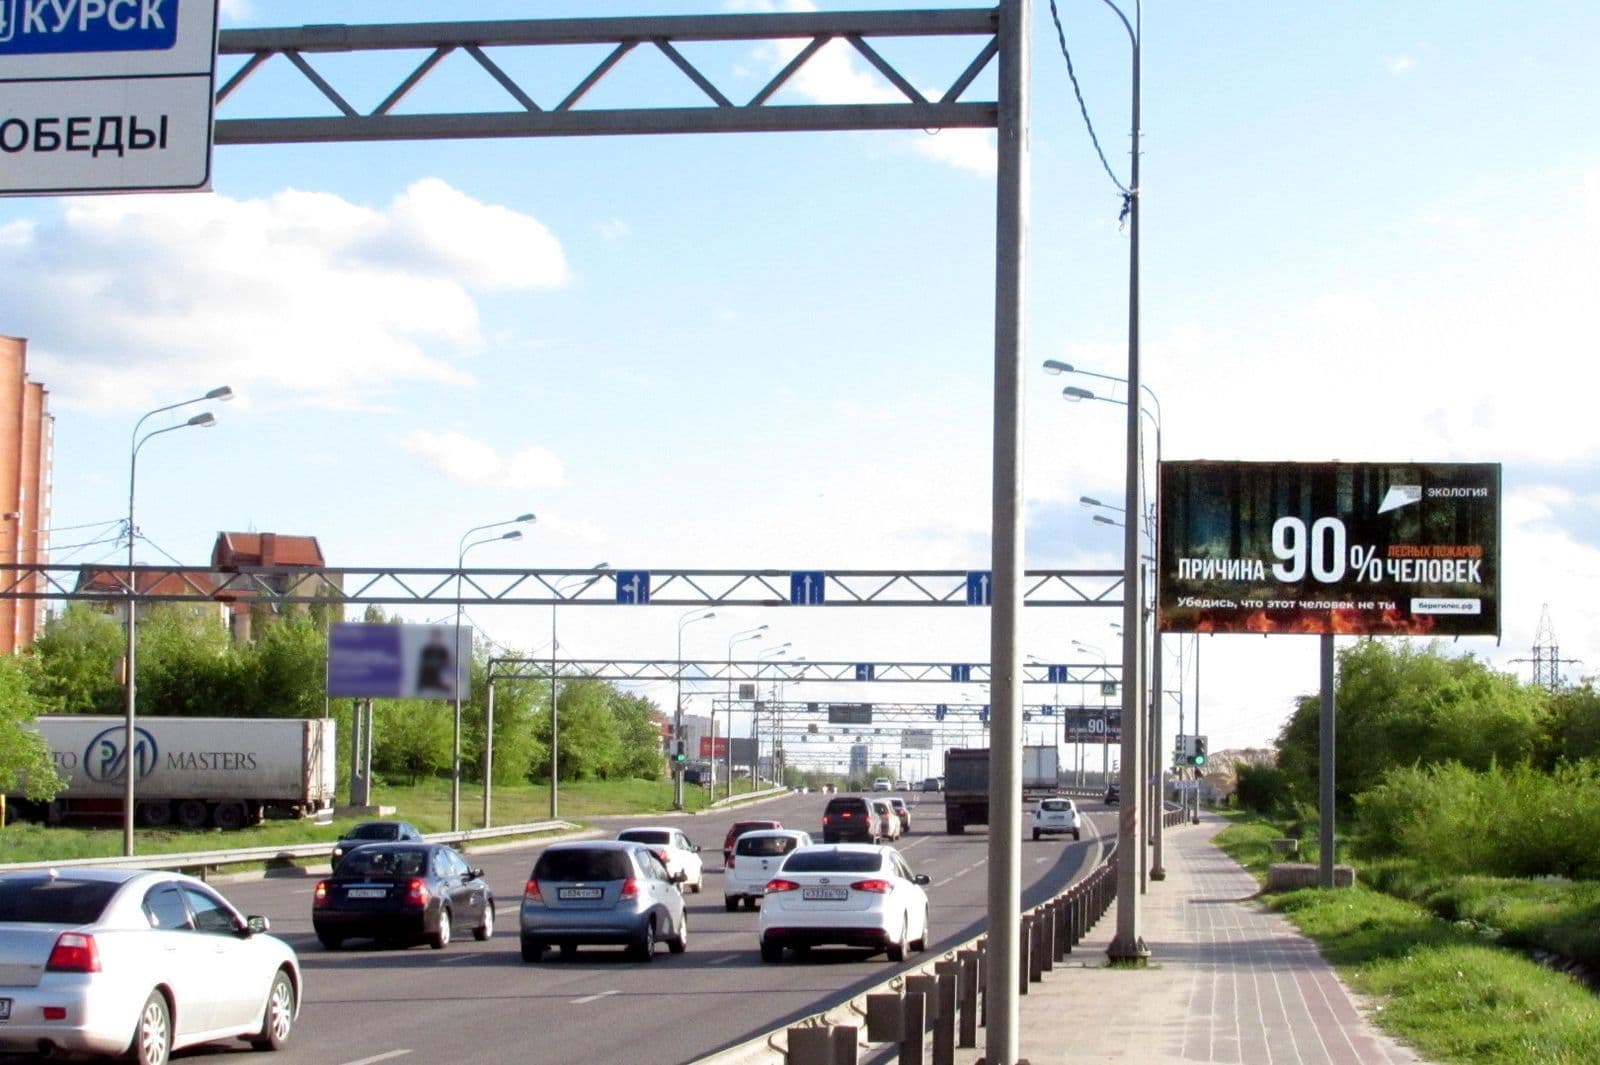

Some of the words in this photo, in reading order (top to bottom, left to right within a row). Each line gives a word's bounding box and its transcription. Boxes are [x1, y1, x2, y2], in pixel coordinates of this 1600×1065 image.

[23, 0, 166, 34] КУРСК
[0, 115, 168, 157] ОБЕДЫ
[1427, 487, 1488, 498] ЭКОЛОГИЯ
[1388, 545, 1432, 558] ЛЕСНЫХ
[1178, 558, 1266, 581] ПРИЧИНА
[1387, 559, 1482, 584] ЧЕЛОВЕК
[1177, 597, 1237, 611] Убедись,
[1240, 600, 1263, 609] что
[1267, 600, 1295, 609] этот
[1299, 600, 1354, 610] человек
[1358, 601, 1374, 610] не
[1377, 601, 1396, 610] ты
[167, 751, 257, 771] MASTERS
